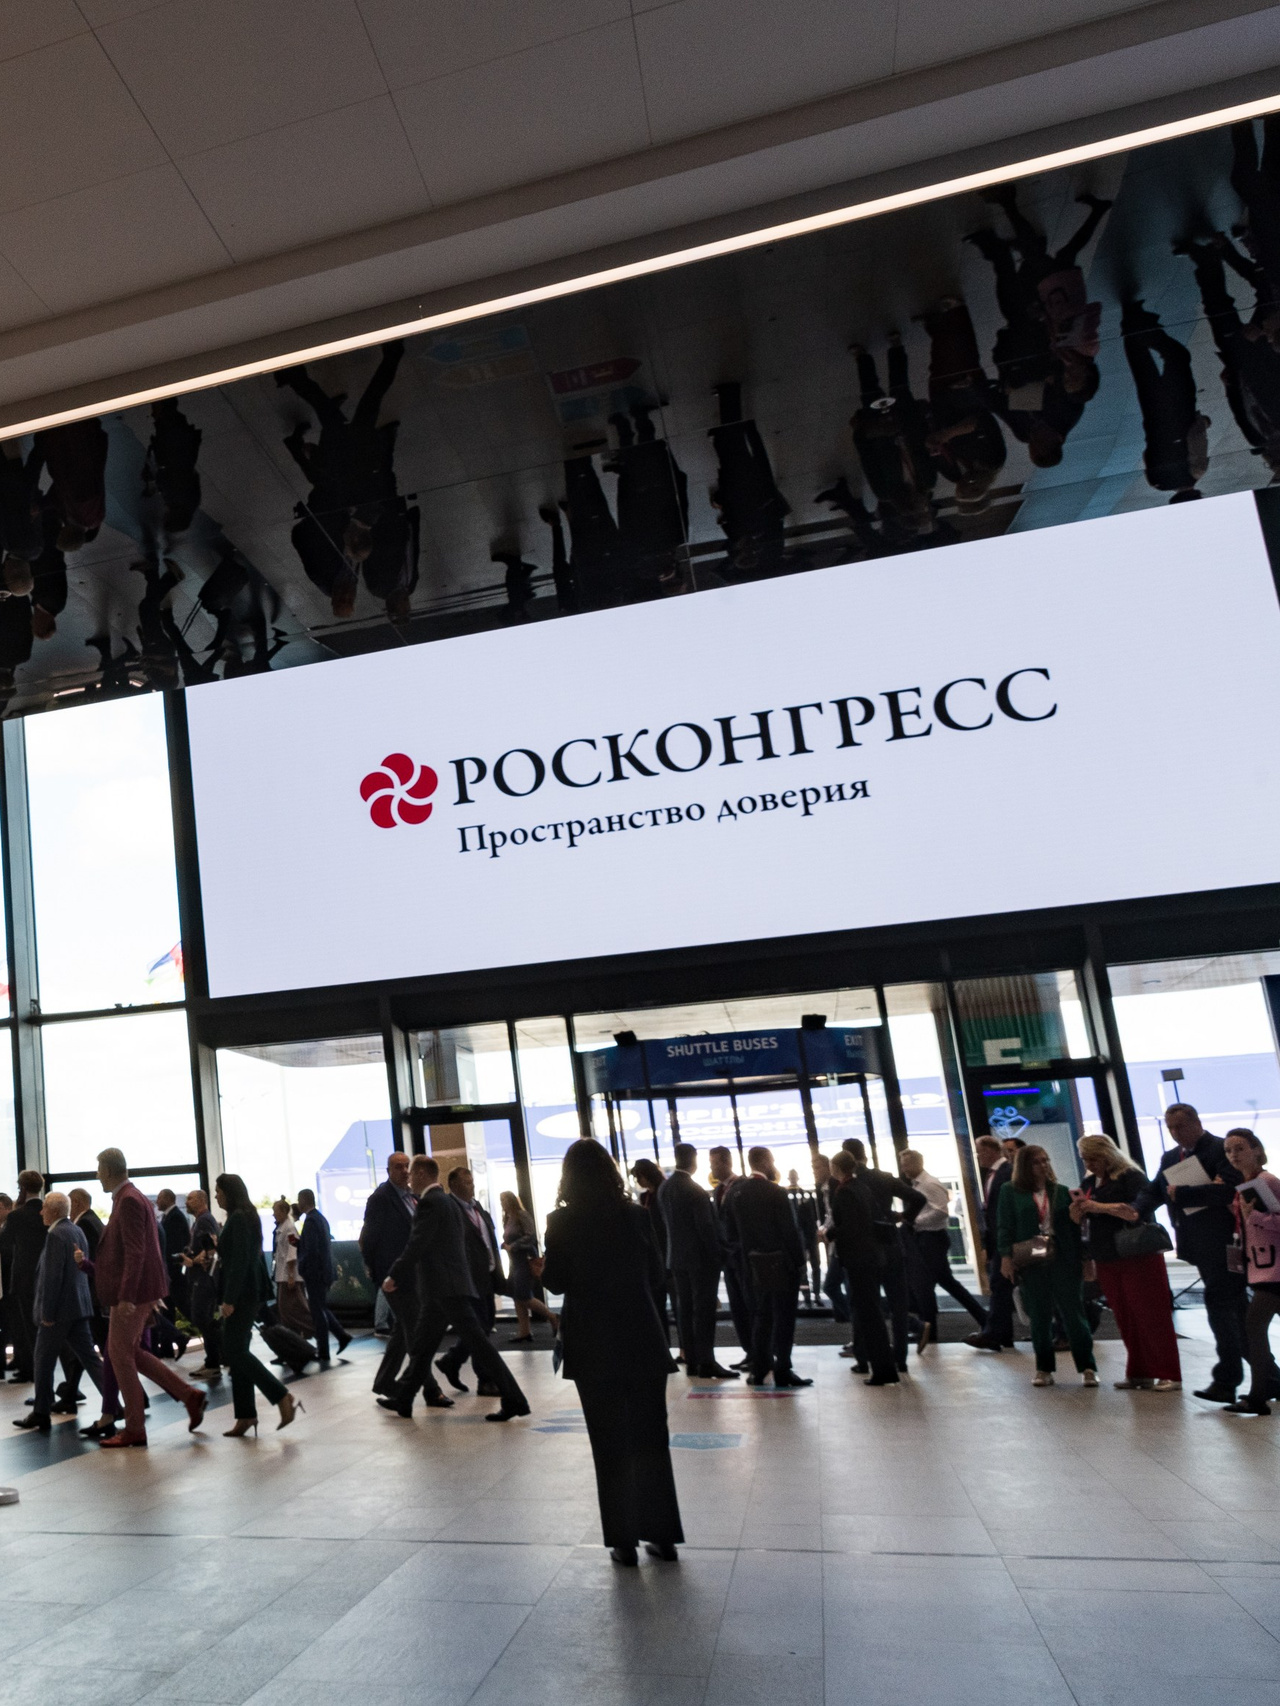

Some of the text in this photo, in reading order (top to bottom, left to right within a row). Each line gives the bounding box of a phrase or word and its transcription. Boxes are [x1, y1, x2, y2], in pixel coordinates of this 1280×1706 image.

[449, 667, 1058, 806] РОСКОНГРЕСС
[457, 778, 872, 859] Пространство доверия
[665, 1036, 779, 1058] SHUTTLE BUSES
